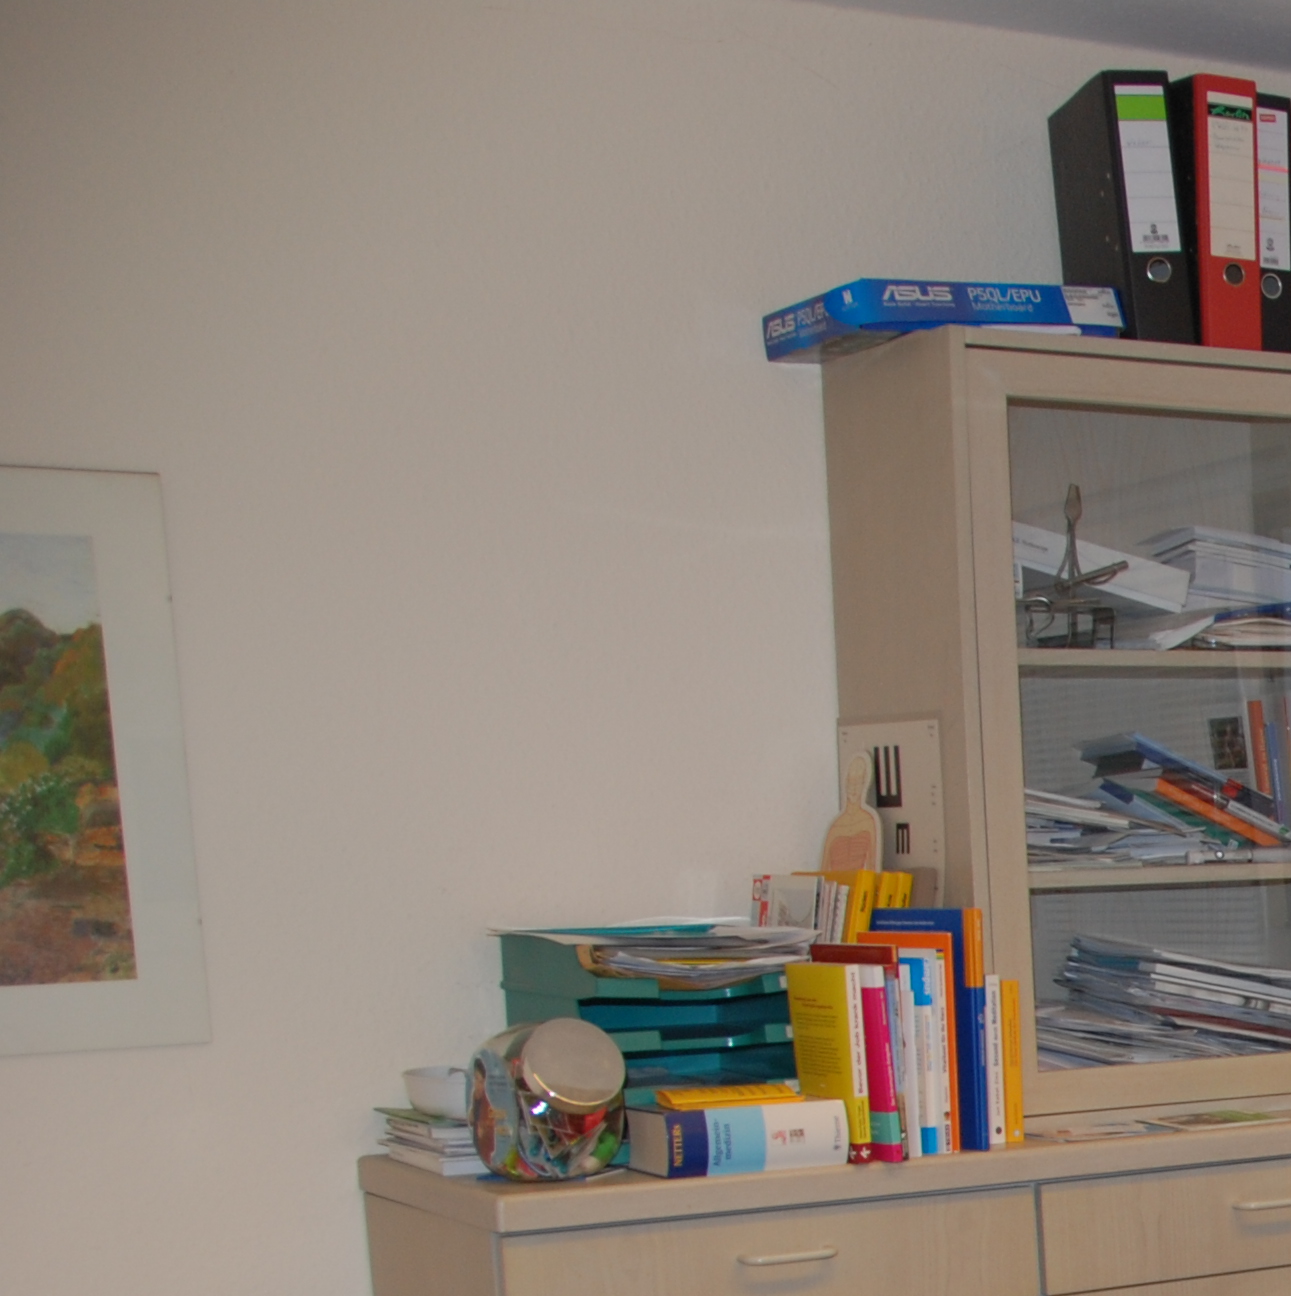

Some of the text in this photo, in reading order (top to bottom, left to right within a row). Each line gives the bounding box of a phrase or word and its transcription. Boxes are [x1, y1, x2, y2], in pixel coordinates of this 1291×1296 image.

[882, 285, 953, 301] ASUS
[971, 301, 1035, 313] Motherboard
[766, 313, 796, 340] ASUS
[713, 1117, 721, 1166] Allgemein-
[834, 1115, 842, 1144] Thieme
[672, 1123, 683, 1167] NETTERS
